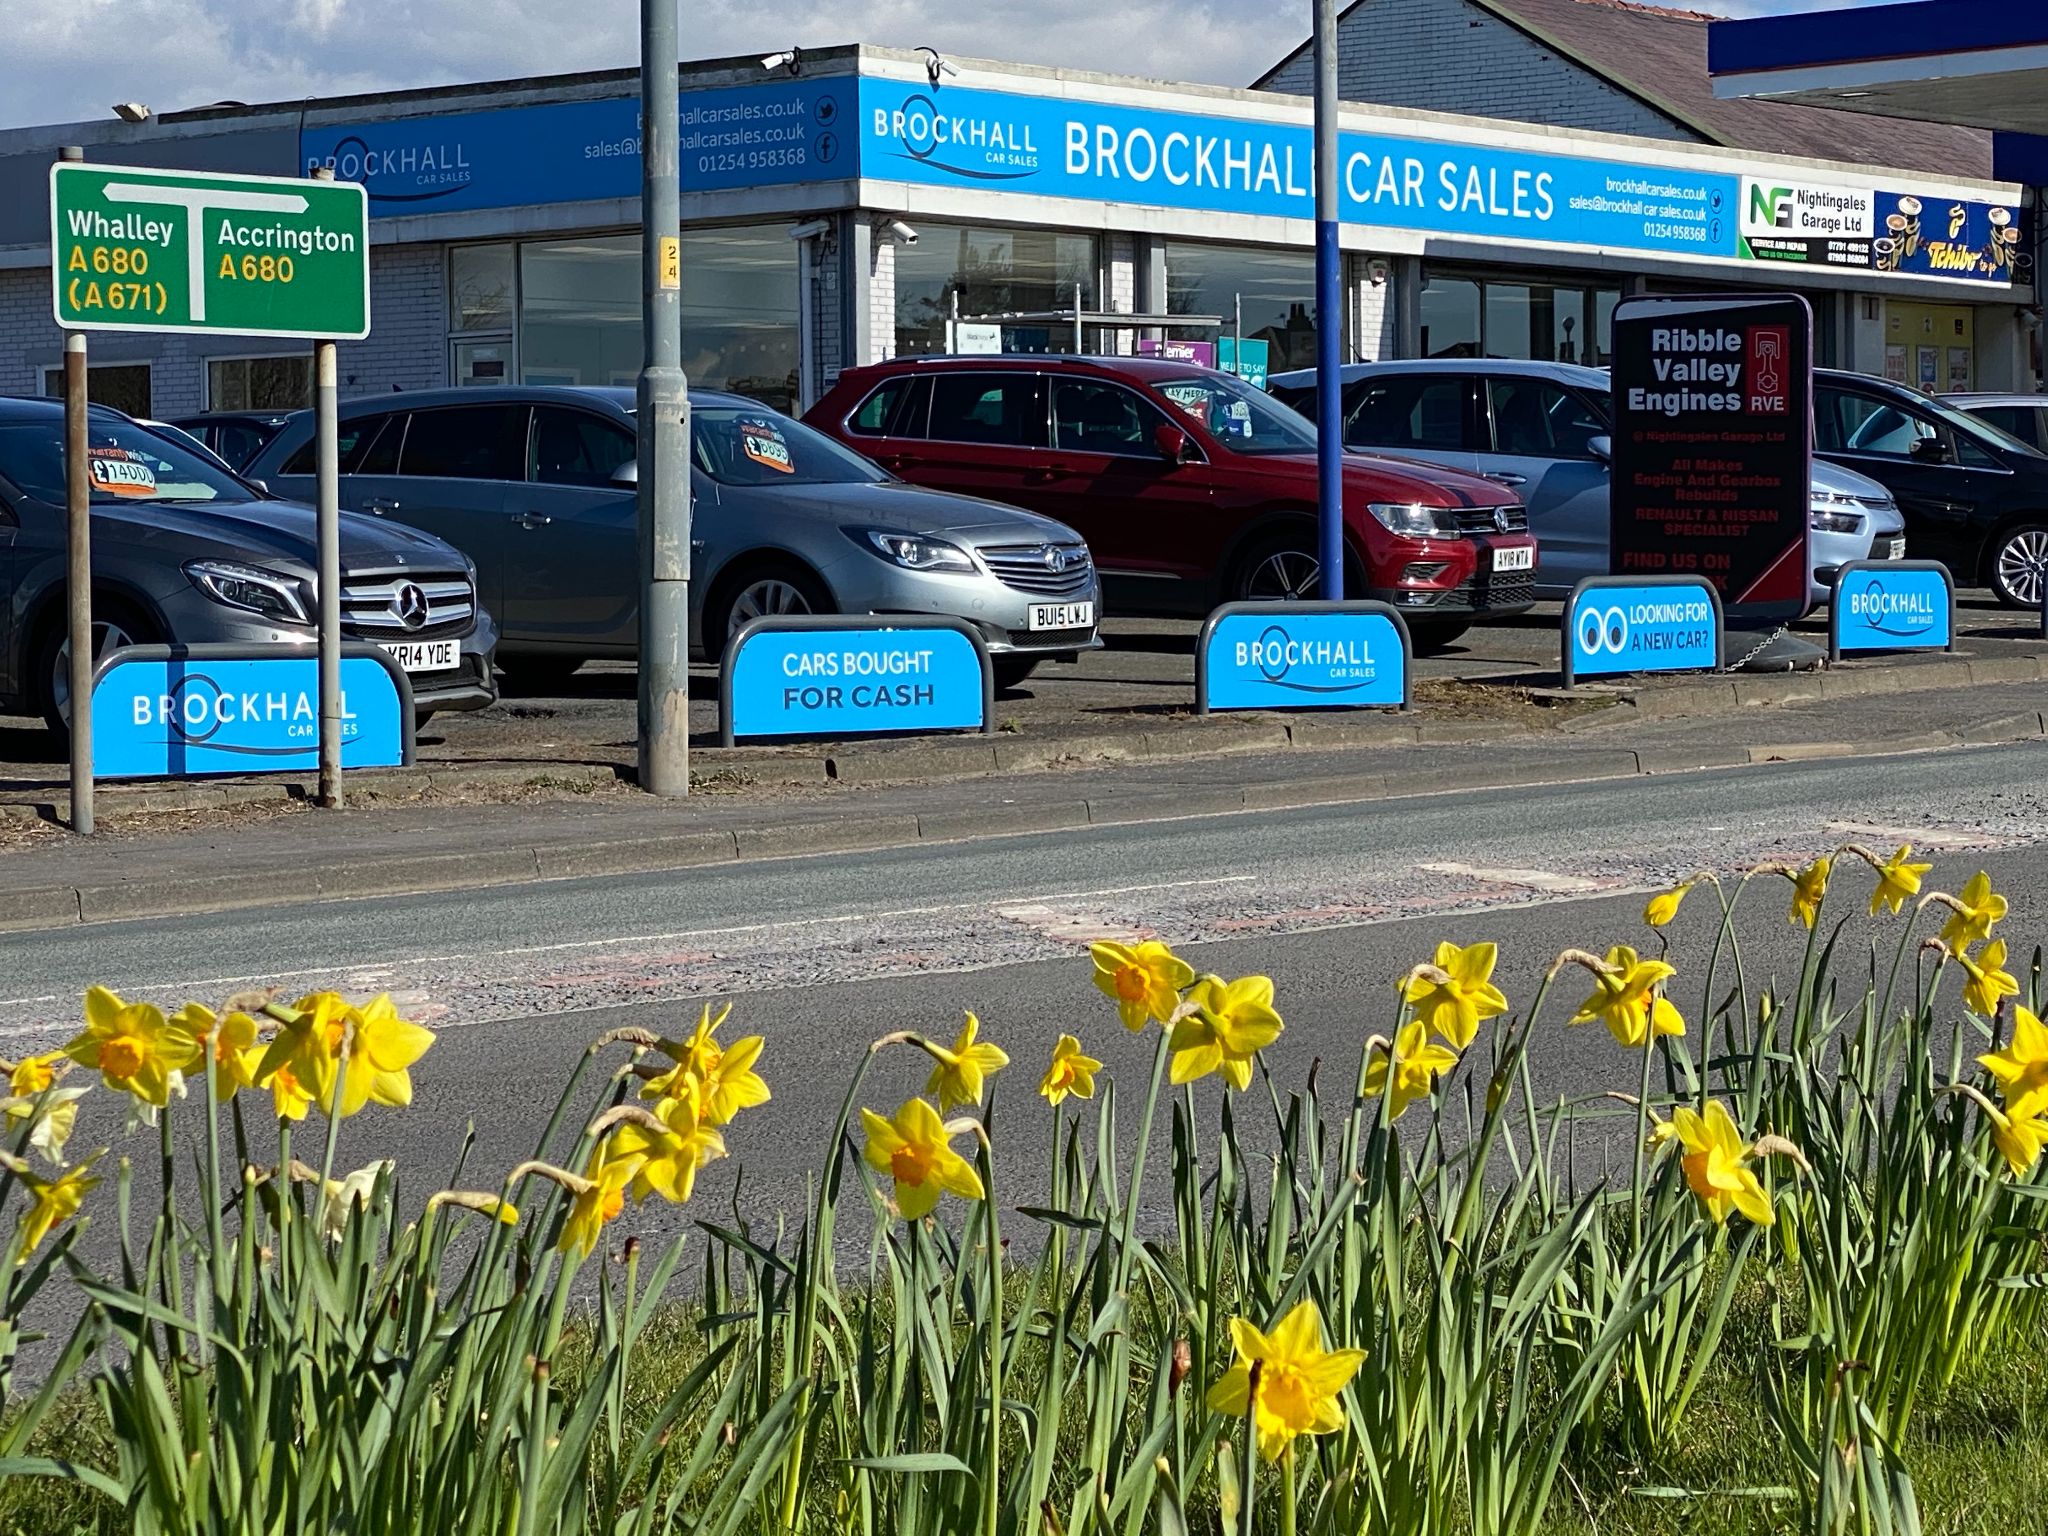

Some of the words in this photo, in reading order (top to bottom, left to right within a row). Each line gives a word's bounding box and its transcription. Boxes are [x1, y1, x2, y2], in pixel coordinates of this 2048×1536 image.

[874, 107, 1038, 153] BROCKHALL
[699, 152, 745, 173] 01254
[749, 147, 806, 169] 958368
[985, 151, 1006, 164] CAR
[1007, 152, 1039, 168] SALES
[416, 174, 437, 185] CAR
[439, 171, 471, 184] SALES
[1066, 121, 1316, 198] BROCKHAL
[1346, 151, 1425, 208] CAR
[1438, 161, 1554, 221] SALES
[1606, 176, 1707, 201] brockhallcarsales.co.uk
[1797, 189, 1866, 212] Nightingales
[67, 208, 174, 247] Whalley
[1644, 222, 1672, 238] 01254
[1672, 226, 1707, 242] 958368
[1801, 212, 1841, 233] Garage
[1844, 216, 1862, 232] Ltd
[218, 218, 355, 255] Accrington
[1751, 239, 1775, 249] SERVICE
[1928, 241, 1982, 272] Tchibo
[1652, 329, 1741, 352] Ribble
[1653, 359, 1741, 387] Valley
[1628, 388, 1742, 417] Engines
[1751, 396, 1785, 412] RVE
[1646, 431, 1718, 443] Nightingales
[1720, 432, 1761, 444] Garage
[1766, 431, 1787, 442] Ltd
[1672, 458, 1692, 471] All
[1695, 458, 1744, 471] Makes
[1633, 473, 1684, 488] Engine
[1687, 473, 1715, 487] And
[1719, 474, 1782, 488] Gearbox
[1674, 489, 1739, 502] Rebuilds
[1635, 507, 1702, 521] RENAULT
[1706, 509, 1717, 521] &
[1722, 509, 1779, 523] NISSAN
[1663, 523, 1751, 537] SPECIALIST
[1622, 552, 1667, 568] FIND
[1671, 553, 1697, 569] US
[1703, 554, 1731, 569] ON
[1630, 604, 1684, 624] LOOKING
[1686, 602, 1708, 622] FOR
[1851, 593, 1934, 614] BROCKHALL
[1038, 606, 1065, 626] BU15
[1907, 616, 1919, 625] CAR
[1920, 615, 1934, 625] SALES
[1631, 633, 1641, 651] A
[1643, 631, 1674, 651] NEW
[1676, 630, 1709, 650] CAR?
[428, 643, 452, 664] YDE
[783, 652, 839, 677] CARS
[844, 650, 934, 676] BOUGHT
[1235, 640, 1375, 667] BROCKHALL
[1330, 667, 1347, 678] CAR
[1349, 667, 1376, 678] SALES
[133, 690, 357, 726] BROCKHAL
[784, 686, 843, 711] FOR
[851, 684, 935, 708] CASH
[287, 724, 314, 738] CAR
